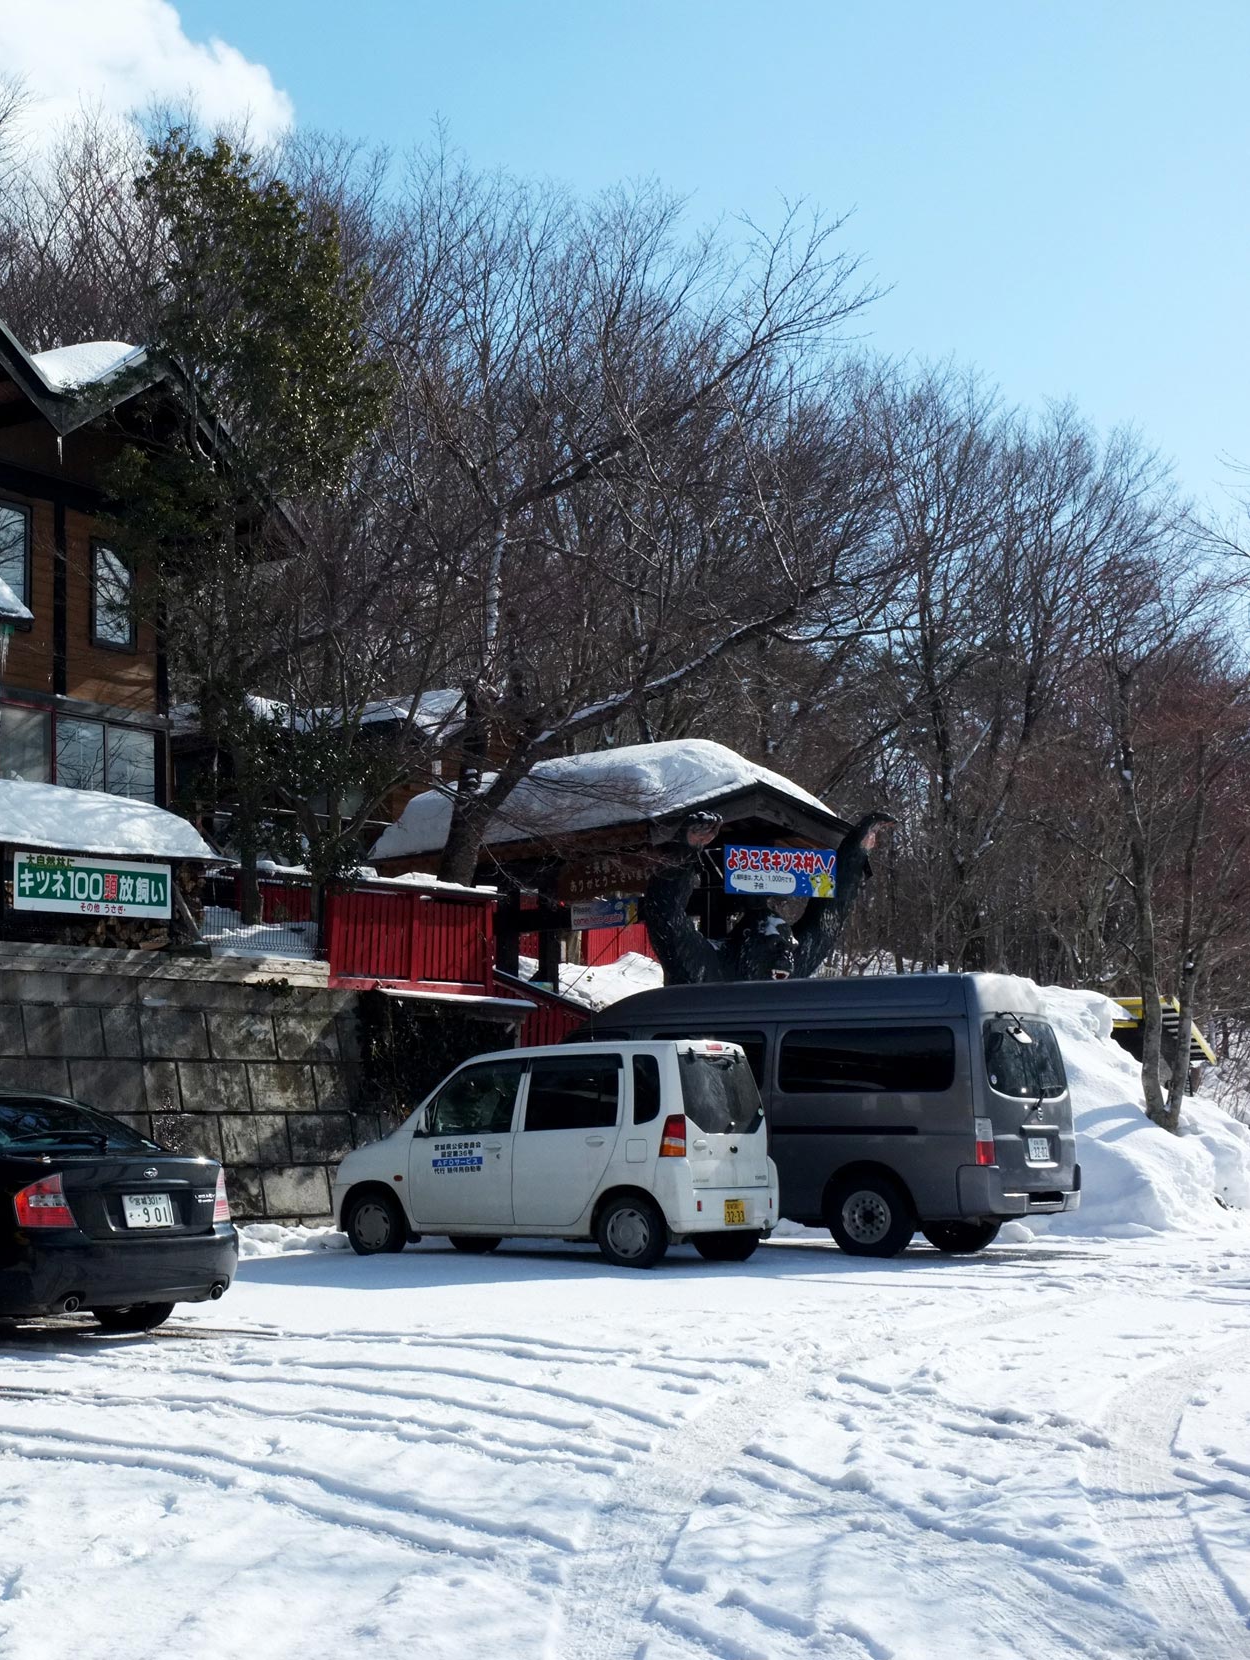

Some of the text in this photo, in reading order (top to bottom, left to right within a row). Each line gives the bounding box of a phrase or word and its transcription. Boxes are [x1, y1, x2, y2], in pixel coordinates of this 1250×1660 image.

[19, 869, 165, 903] キツネ100頭放飼い
[80, 902, 100, 913] その他
